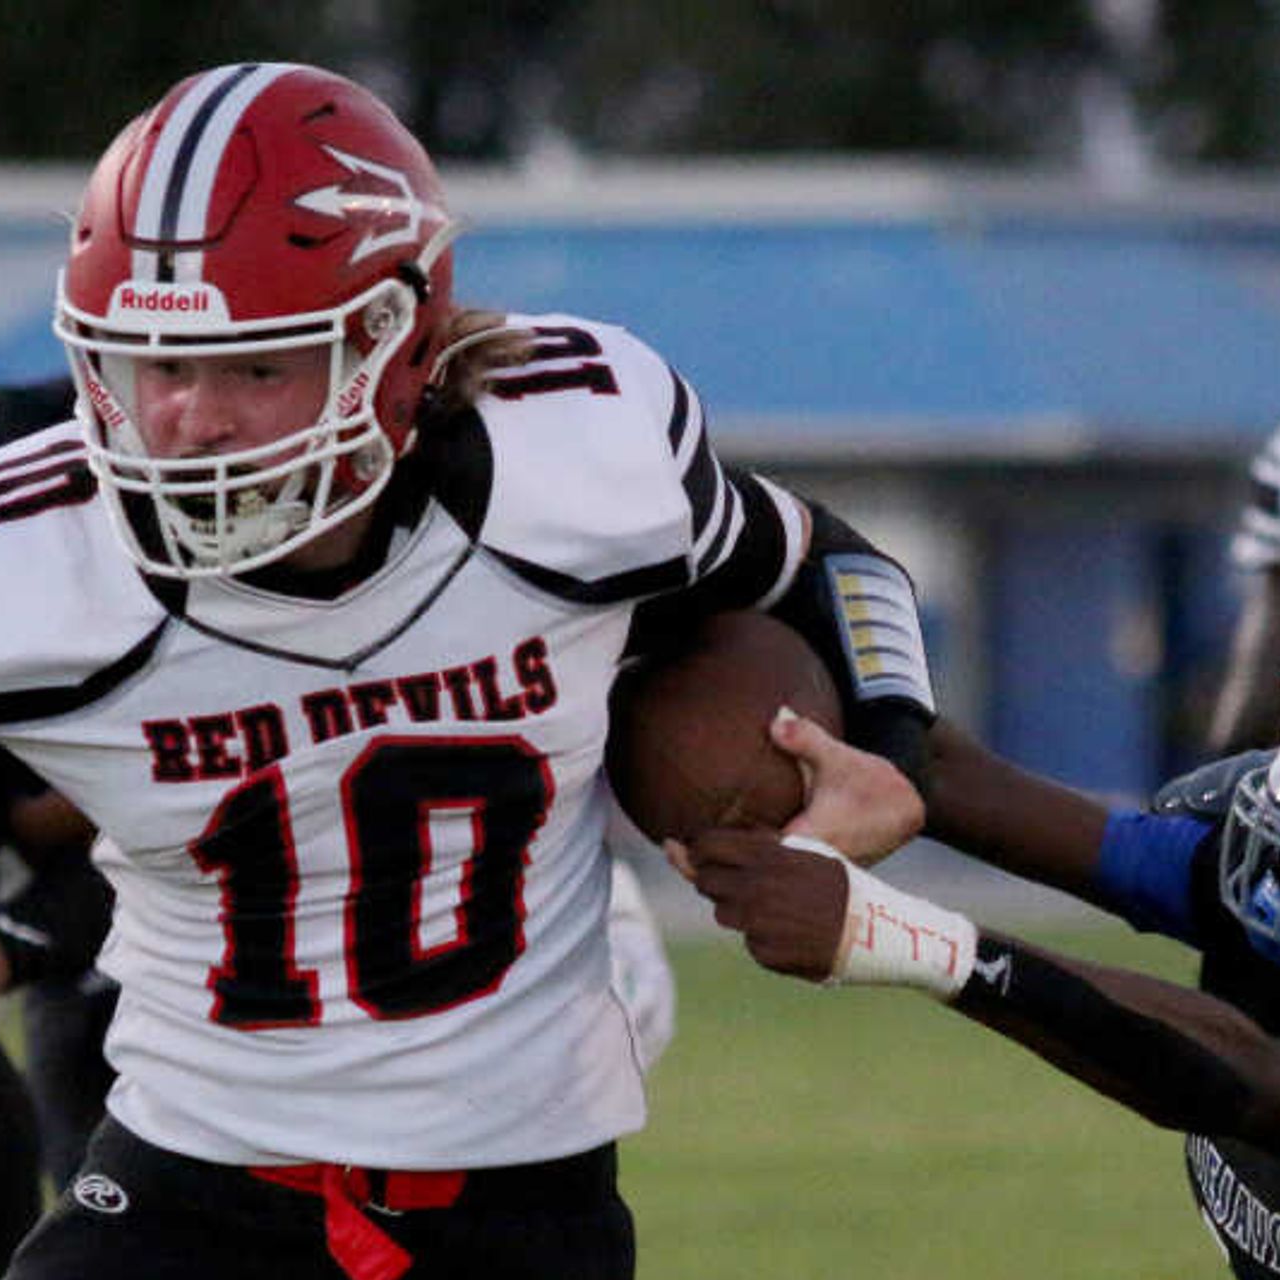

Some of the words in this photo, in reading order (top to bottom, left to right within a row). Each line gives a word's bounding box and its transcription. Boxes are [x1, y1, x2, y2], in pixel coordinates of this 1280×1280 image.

[120, 288, 208, 312] Riddell
[142, 703, 290, 783] RED
[300, 636, 558, 745] DEVILS
[185, 734, 556, 1033] 10
